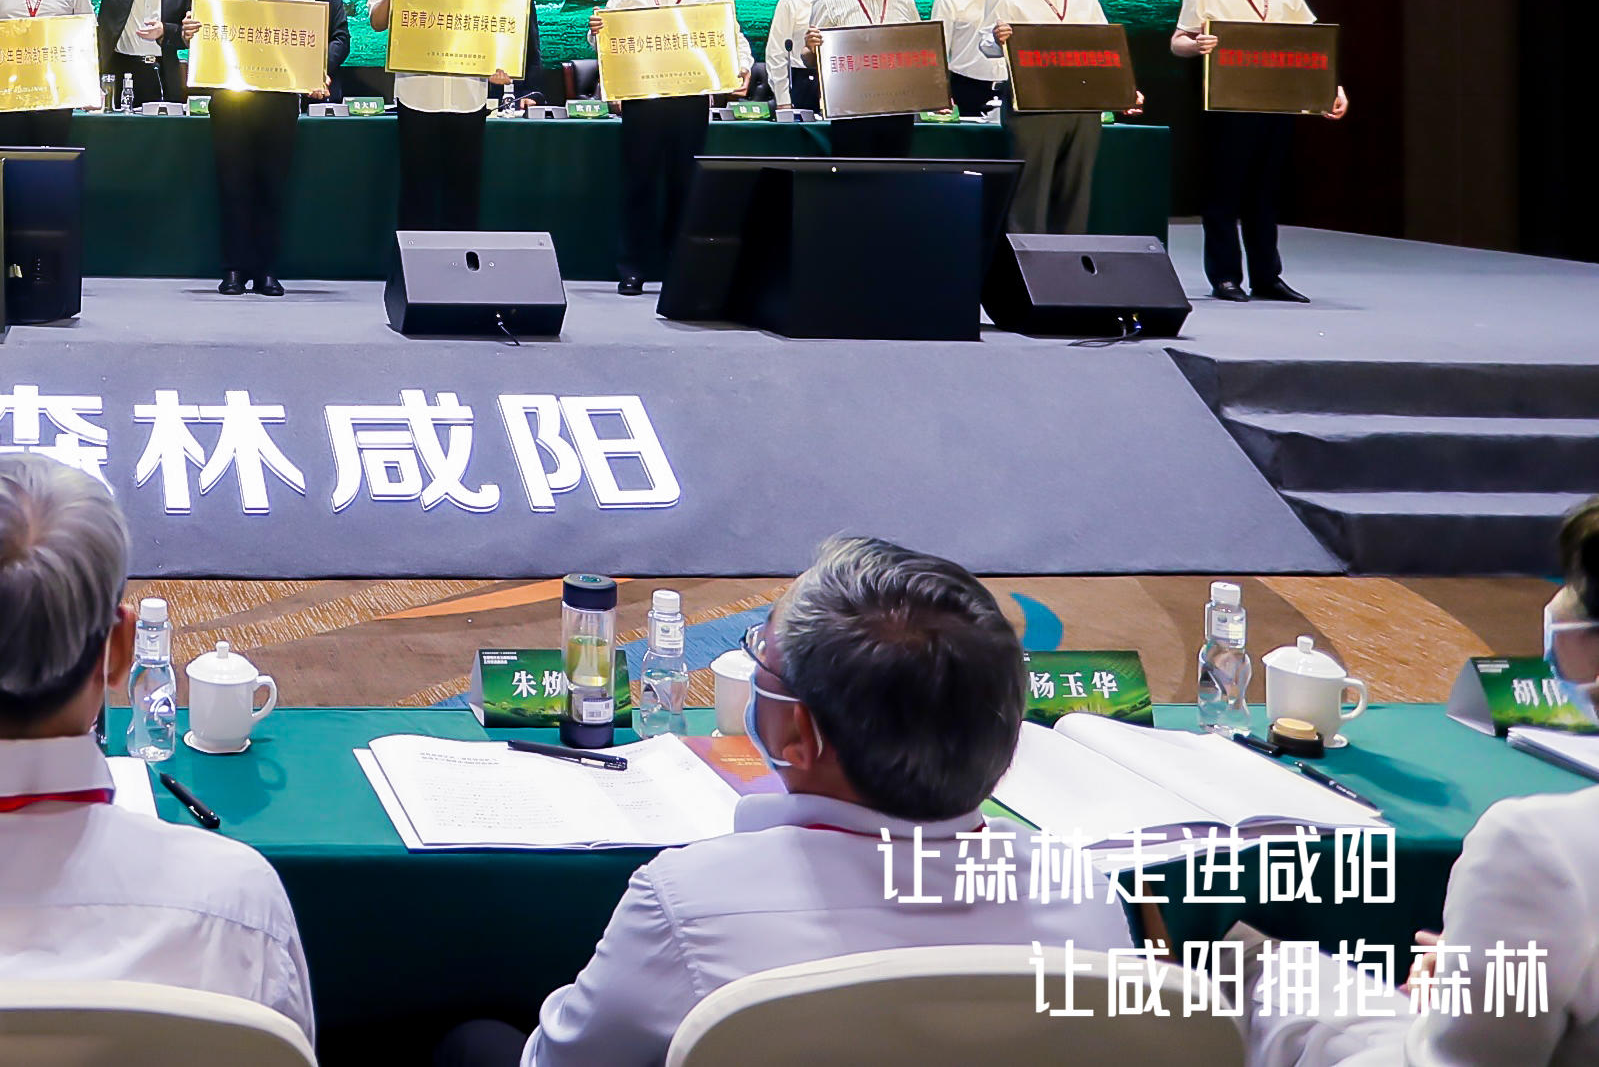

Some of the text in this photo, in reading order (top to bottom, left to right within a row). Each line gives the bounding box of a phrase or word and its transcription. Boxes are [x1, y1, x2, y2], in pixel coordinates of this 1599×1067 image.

[401, 10, 517, 34] 国家青少年自然教育绿色营地
[1029, 671, 1119, 699] 杨玉华
